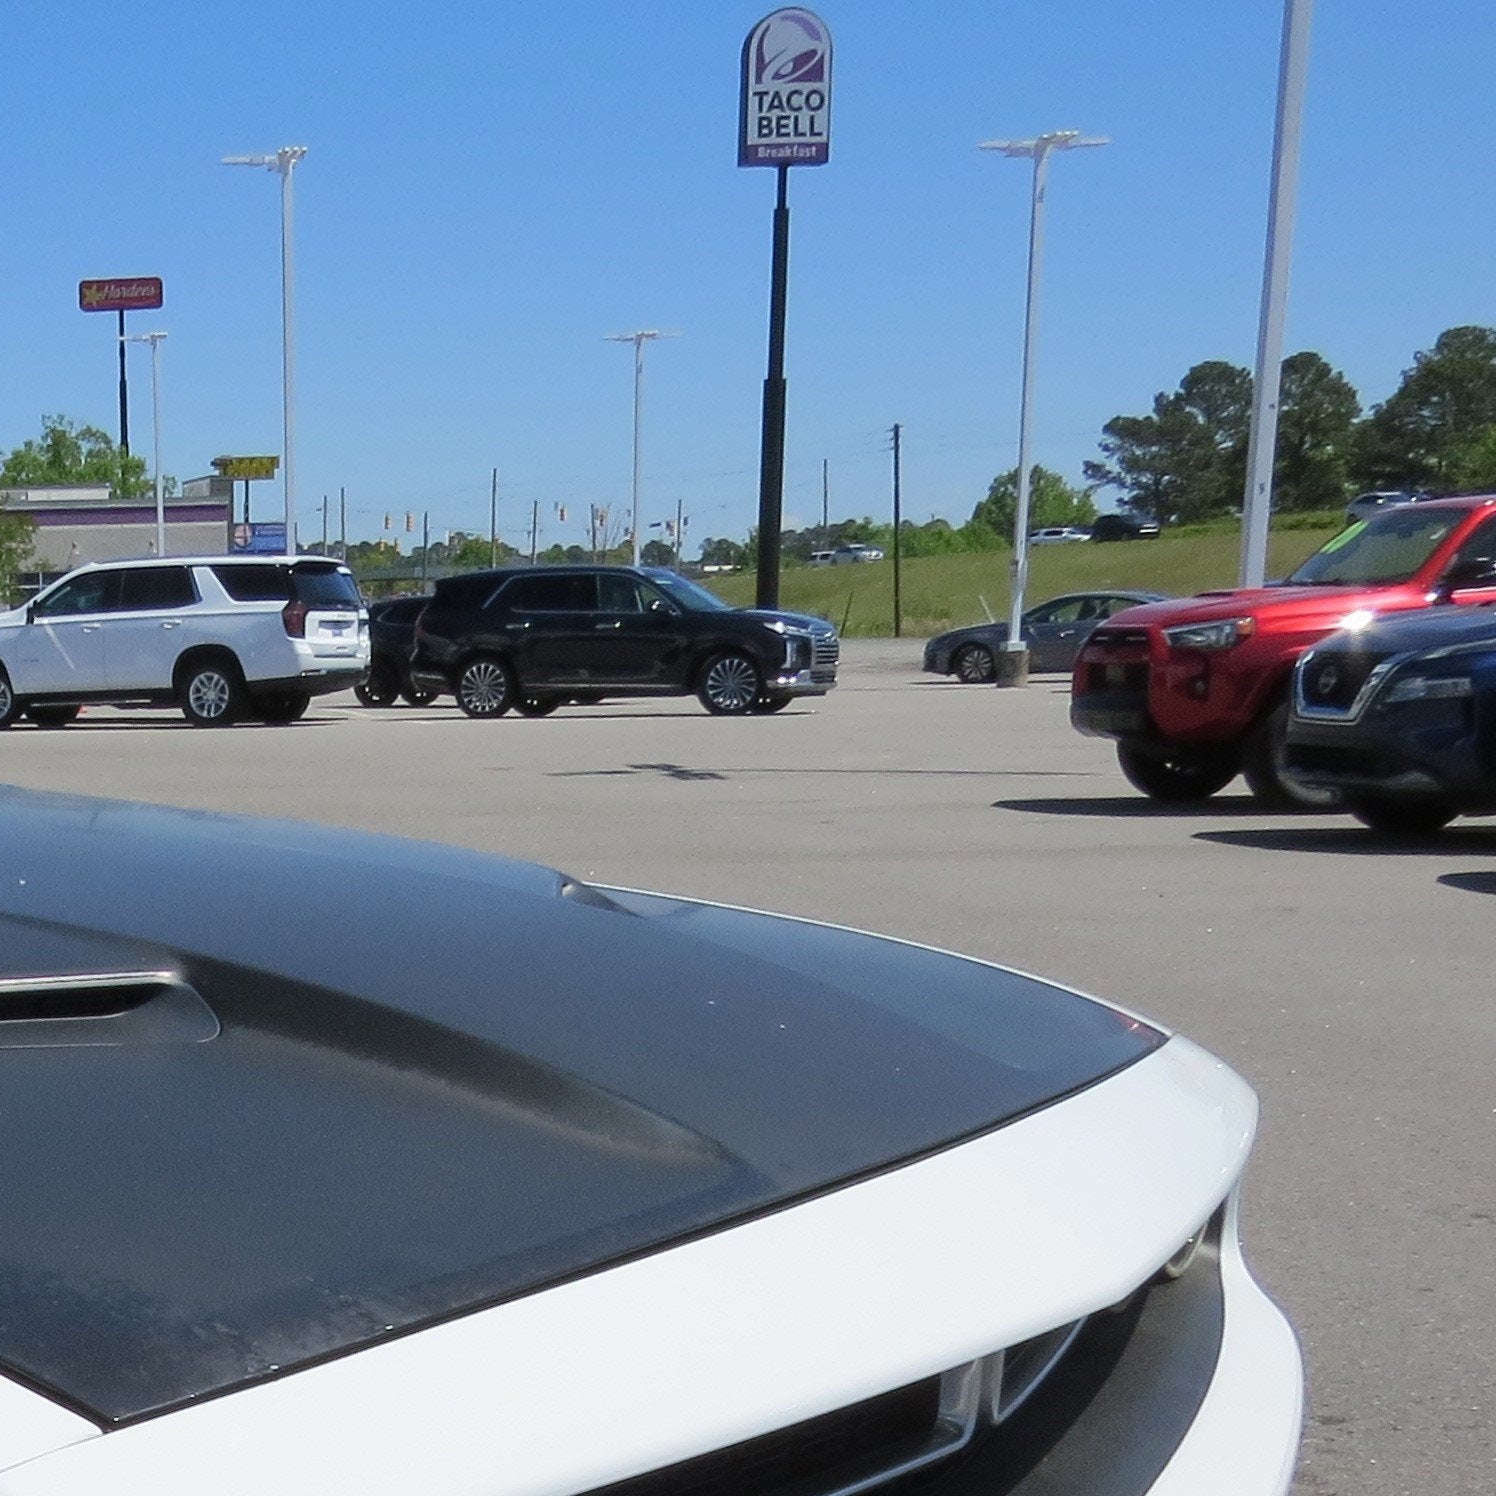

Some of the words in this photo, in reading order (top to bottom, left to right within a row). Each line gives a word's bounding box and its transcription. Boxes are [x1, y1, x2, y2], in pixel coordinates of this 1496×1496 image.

[752, 88, 825, 113] TACO
[757, 114, 823, 139] BELL
[757, 144, 818, 158] Breakfast
